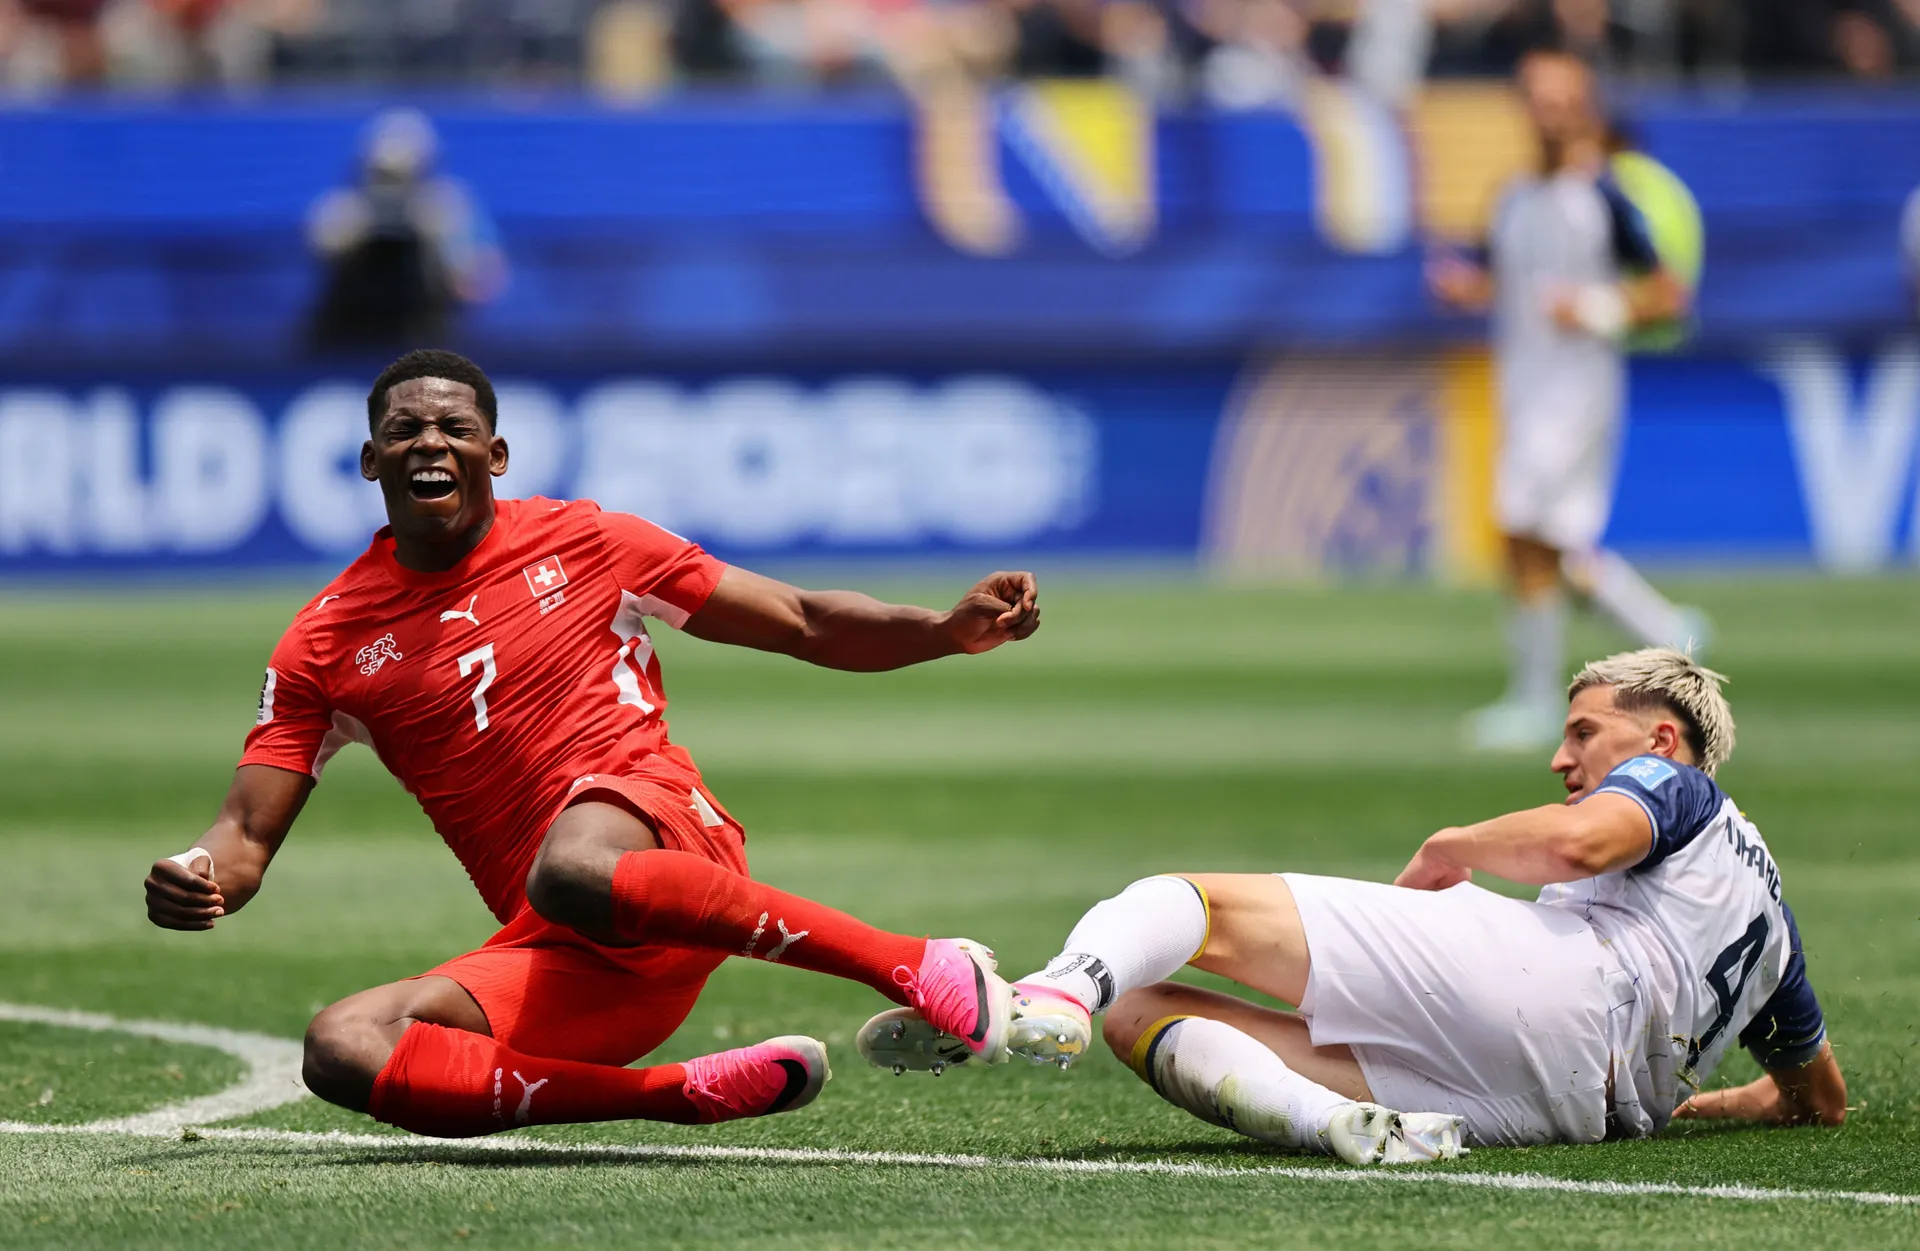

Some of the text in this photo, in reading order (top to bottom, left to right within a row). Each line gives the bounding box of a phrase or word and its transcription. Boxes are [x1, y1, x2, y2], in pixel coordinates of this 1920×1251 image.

[278, 383, 564, 551] CP
[457, 642, 497, 732] 7
[1684, 911, 1769, 1077] 4
